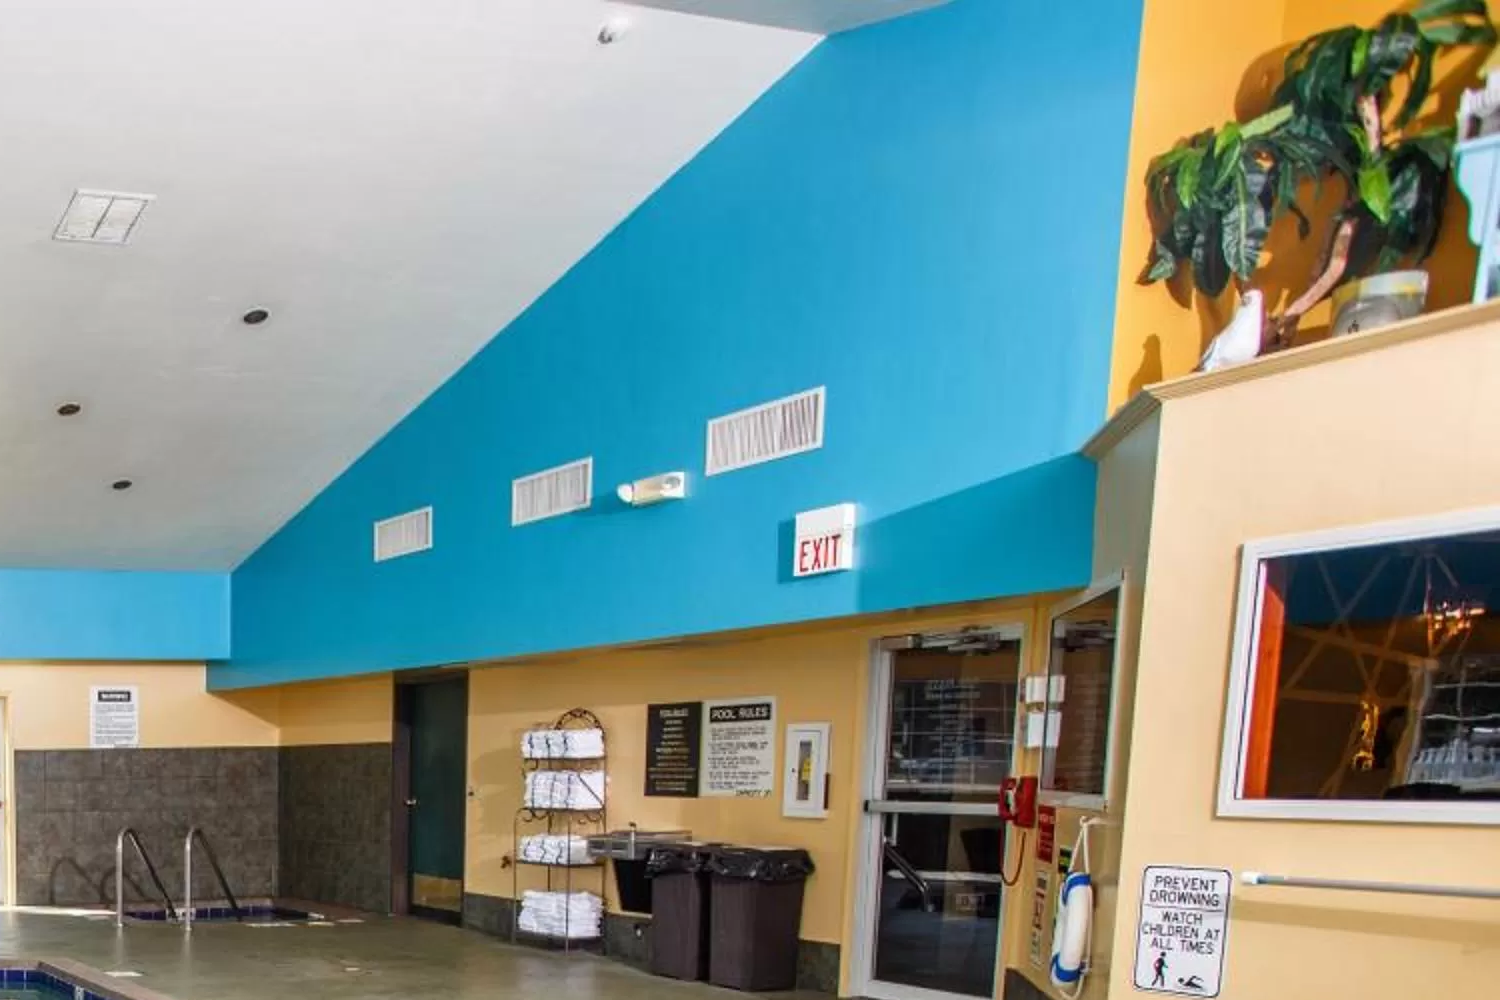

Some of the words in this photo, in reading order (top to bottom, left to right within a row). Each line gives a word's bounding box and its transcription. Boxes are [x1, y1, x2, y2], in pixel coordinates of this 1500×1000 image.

[800, 533, 841, 572] EXIT
[712, 708, 737, 720] POOL
[739, 706, 768, 719] RULES
[1154, 875, 1218, 892] PREVENT
[1149, 889, 1220, 907] DROWNING
[1162, 911, 1203, 927] WATCH
[1142, 922, 1199, 939] CHILDREN
[1204, 928, 1220, 941] AT
[1151, 937, 1173, 951] ALL
[1180, 939, 1215, 955] TIMES
